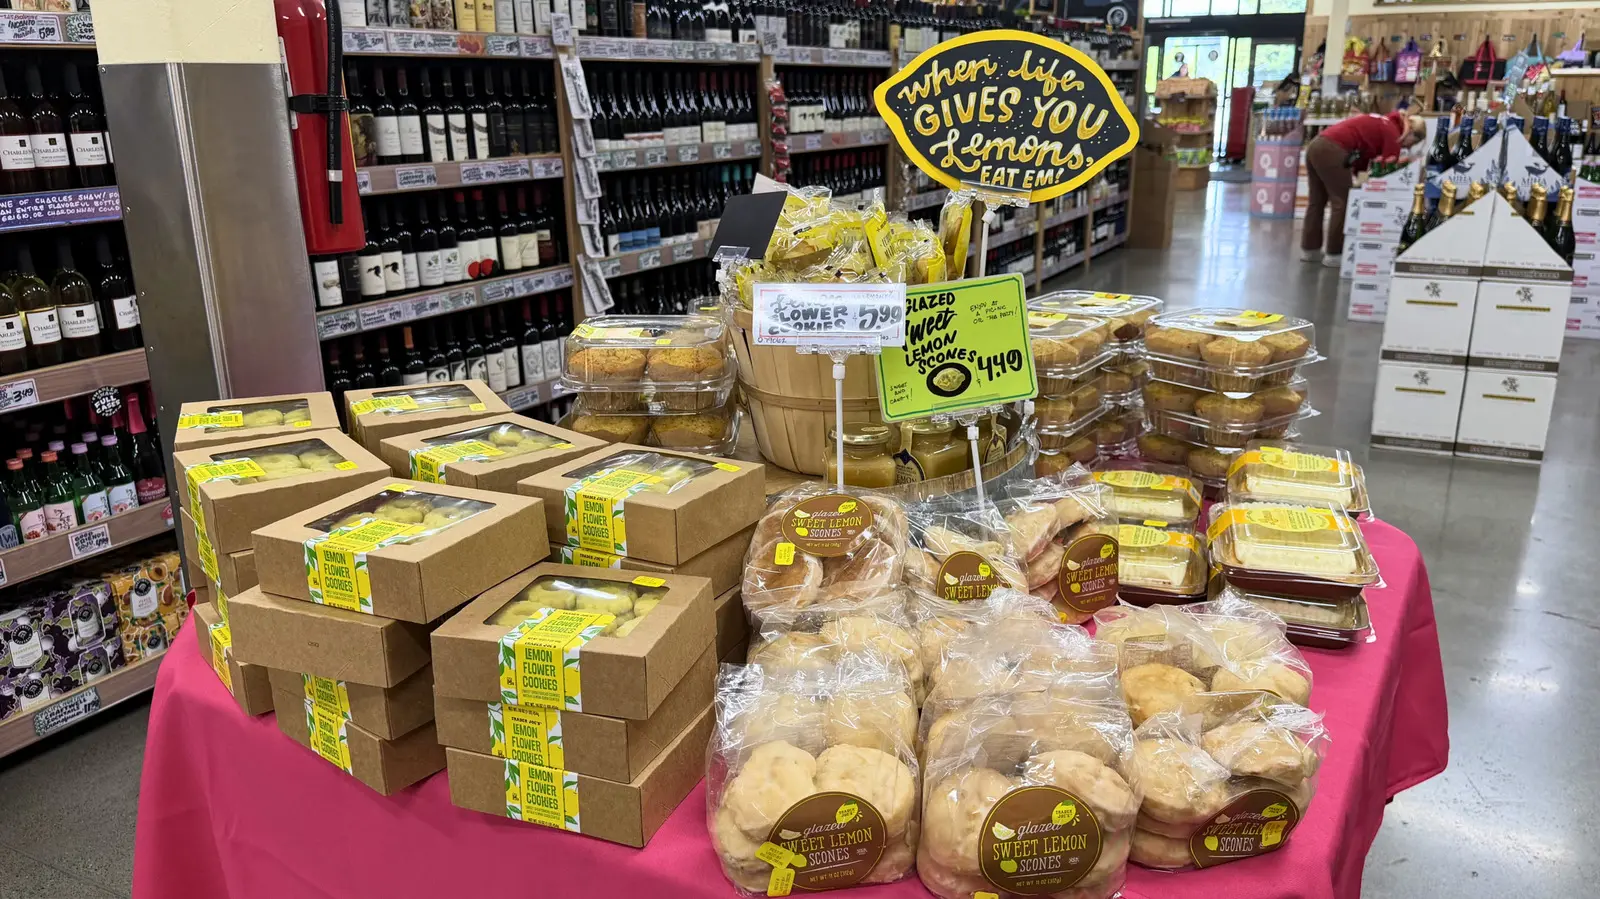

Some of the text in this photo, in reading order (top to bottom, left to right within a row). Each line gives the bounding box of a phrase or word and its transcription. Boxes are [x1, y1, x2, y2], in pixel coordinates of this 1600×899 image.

[913, 86, 1109, 140] GIVES YOU
[980, 165, 1065, 189] EAT EM!
[35, 195, 72, 204] CHARLES
[78, 192, 106, 201] SHAW!
[48, 206, 95, 216] CHARDONNAY
[906, 292, 956, 317] GLAZED
[905, 330, 958, 367] LEMON
[918, 347, 977, 375] SCONES
[978, 349, 1023, 382] 4.49
[94, 396, 116, 408] FULL
[96, 398, 120, 414] CASES
[896, 474, 917, 483] EMON
[584, 500, 604, 513] LEMON
[583, 513, 608, 526] FLOWER
[791, 516, 862, 529] SWEET LEMON
[583, 525, 609, 539] COOKIES
[810, 528, 842, 538] SCONES
[323, 550, 346, 565] LEMON
[324, 564, 350, 579] FLOWER
[1066, 562, 1118, 584] SWEET LEMON
[325, 578, 353, 593] COOKIES
[944, 585, 974, 599] SWEET
[1081, 578, 1105, 593] SCONES
[538, 625, 576, 634] COOKIES
[547, 620, 582, 628] FLOWER
[525, 648, 552, 662] LEMON
[523, 662, 556, 677] FLOWER
[523, 676, 557, 691] COOKIES
[513, 723, 538, 738] LEMON
[512, 736, 542, 752] FLOWER
[512, 749, 543, 767] COOKIES
[528, 767, 553, 783] LEMON
[527, 780, 556, 797] FLOWER
[526, 793, 558, 810] COOKIES
[803, 822, 848, 838] glazed
[1017, 821, 1062, 840] glazed
[1202, 822, 1242, 836] SWEET
[780, 826, 873, 853] SWEET LEMON
[1220, 837, 1254, 852] SCONES
[993, 834, 1088, 861] SWEET LEMON
[809, 847, 850, 866] SCONES
[1020, 855, 1061, 873] SCONES
